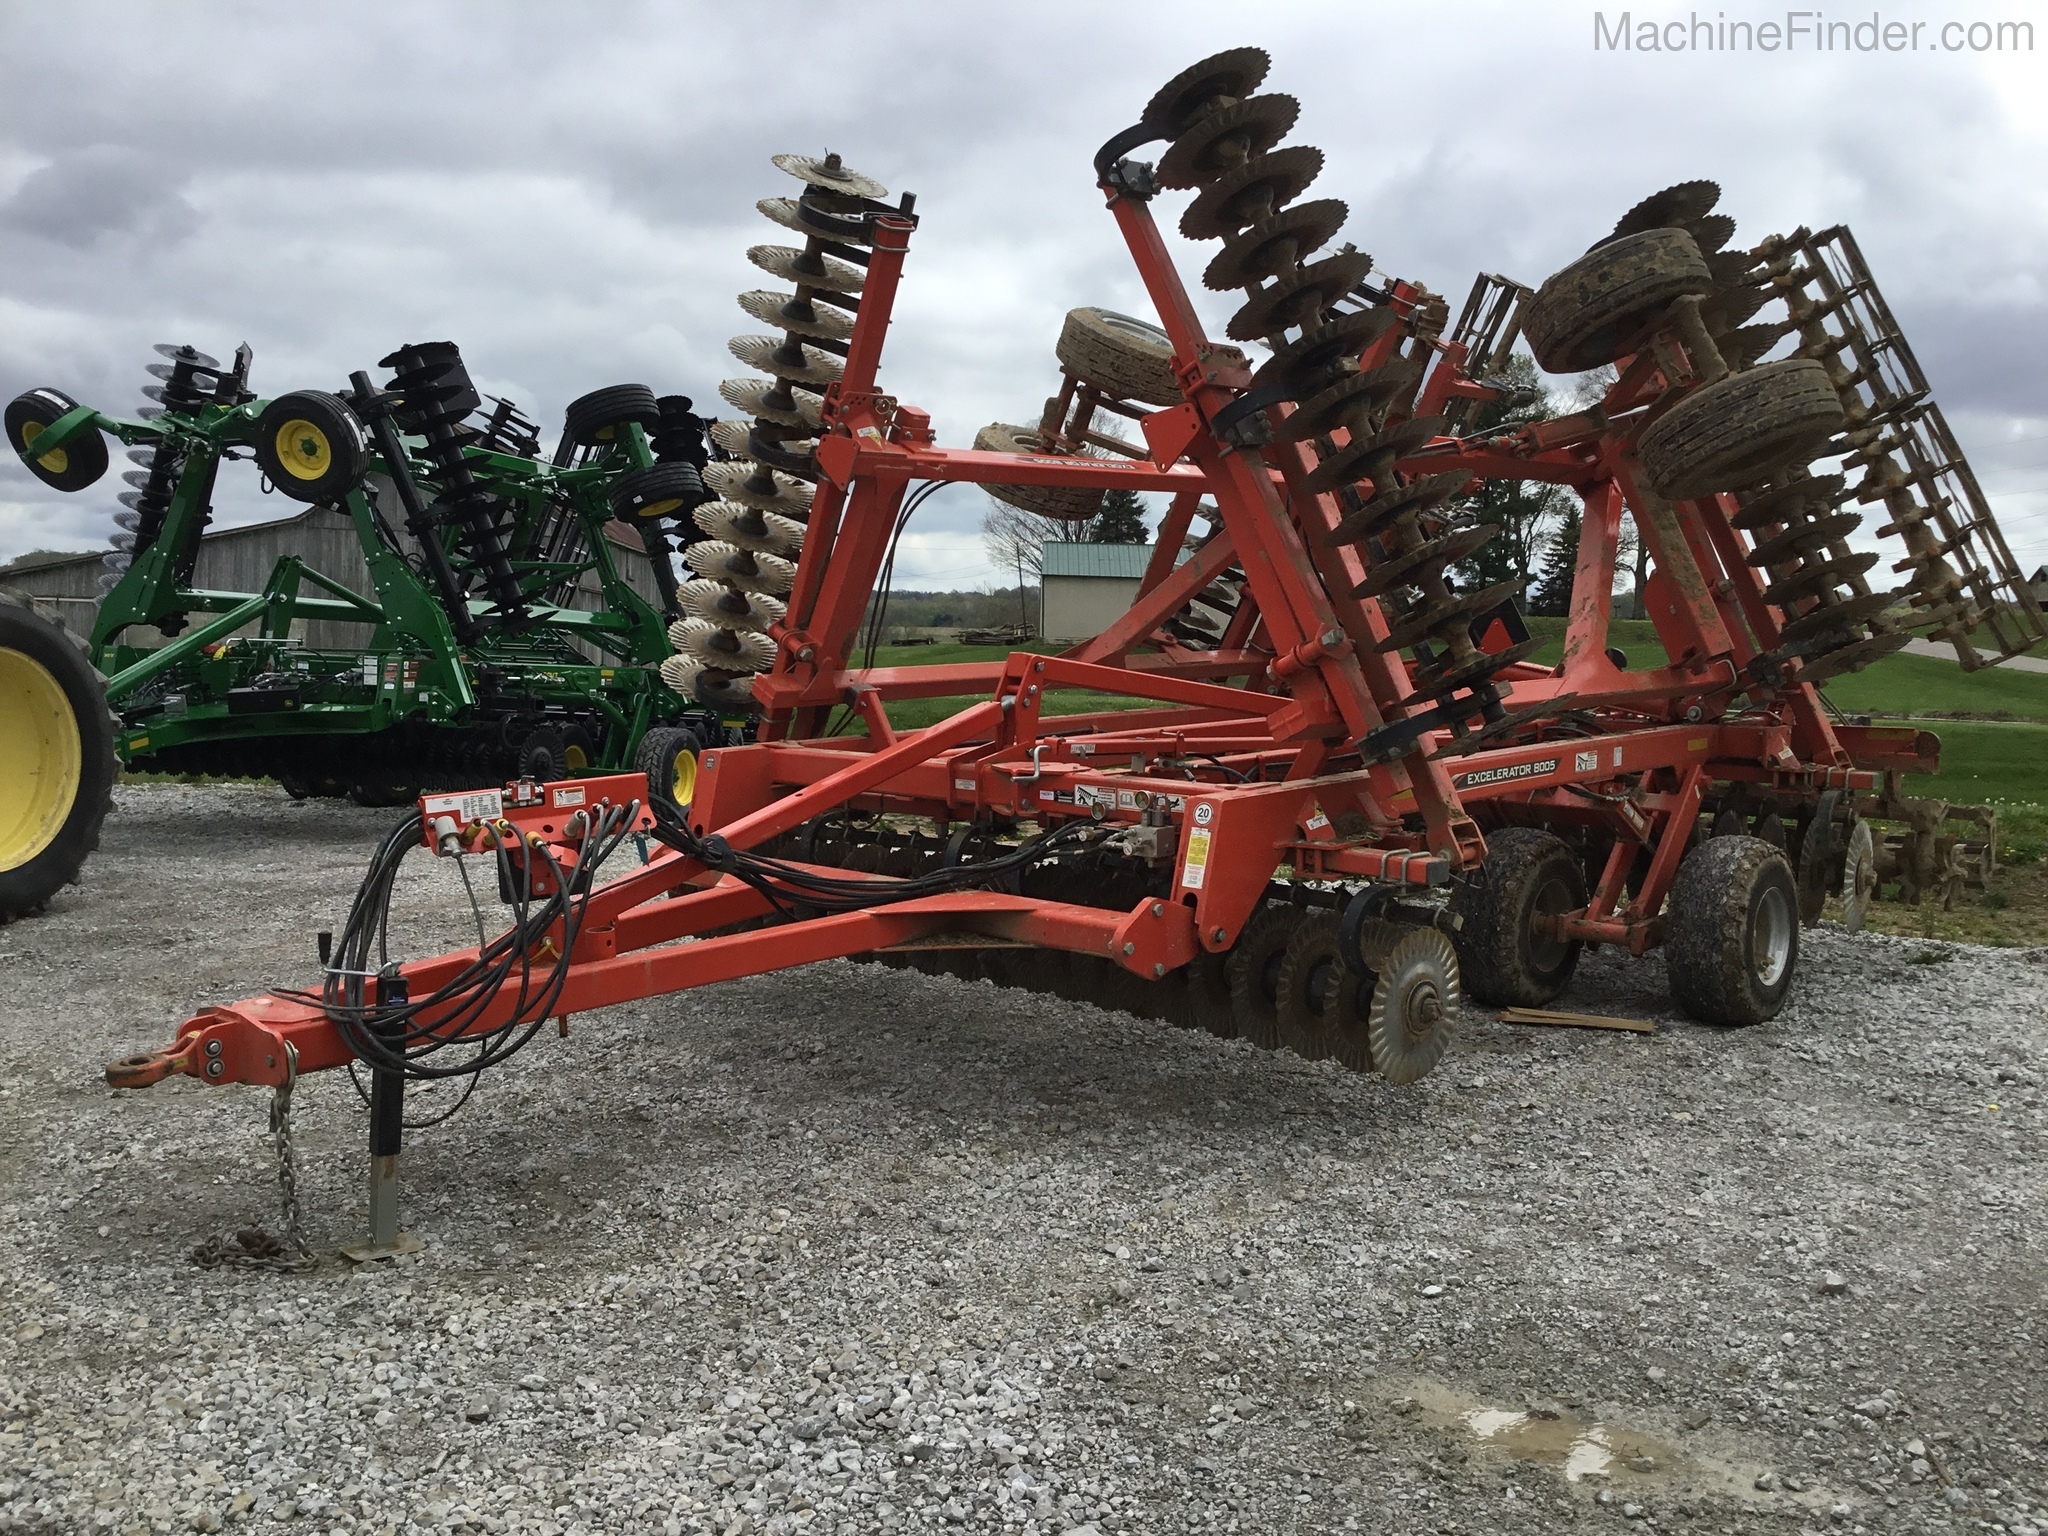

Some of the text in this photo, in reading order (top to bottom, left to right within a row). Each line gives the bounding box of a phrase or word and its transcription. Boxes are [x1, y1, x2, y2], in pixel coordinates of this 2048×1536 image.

[1467, 760, 1556, 785] EXCELERATOR 8005
[1197, 807, 1210, 818] 20
